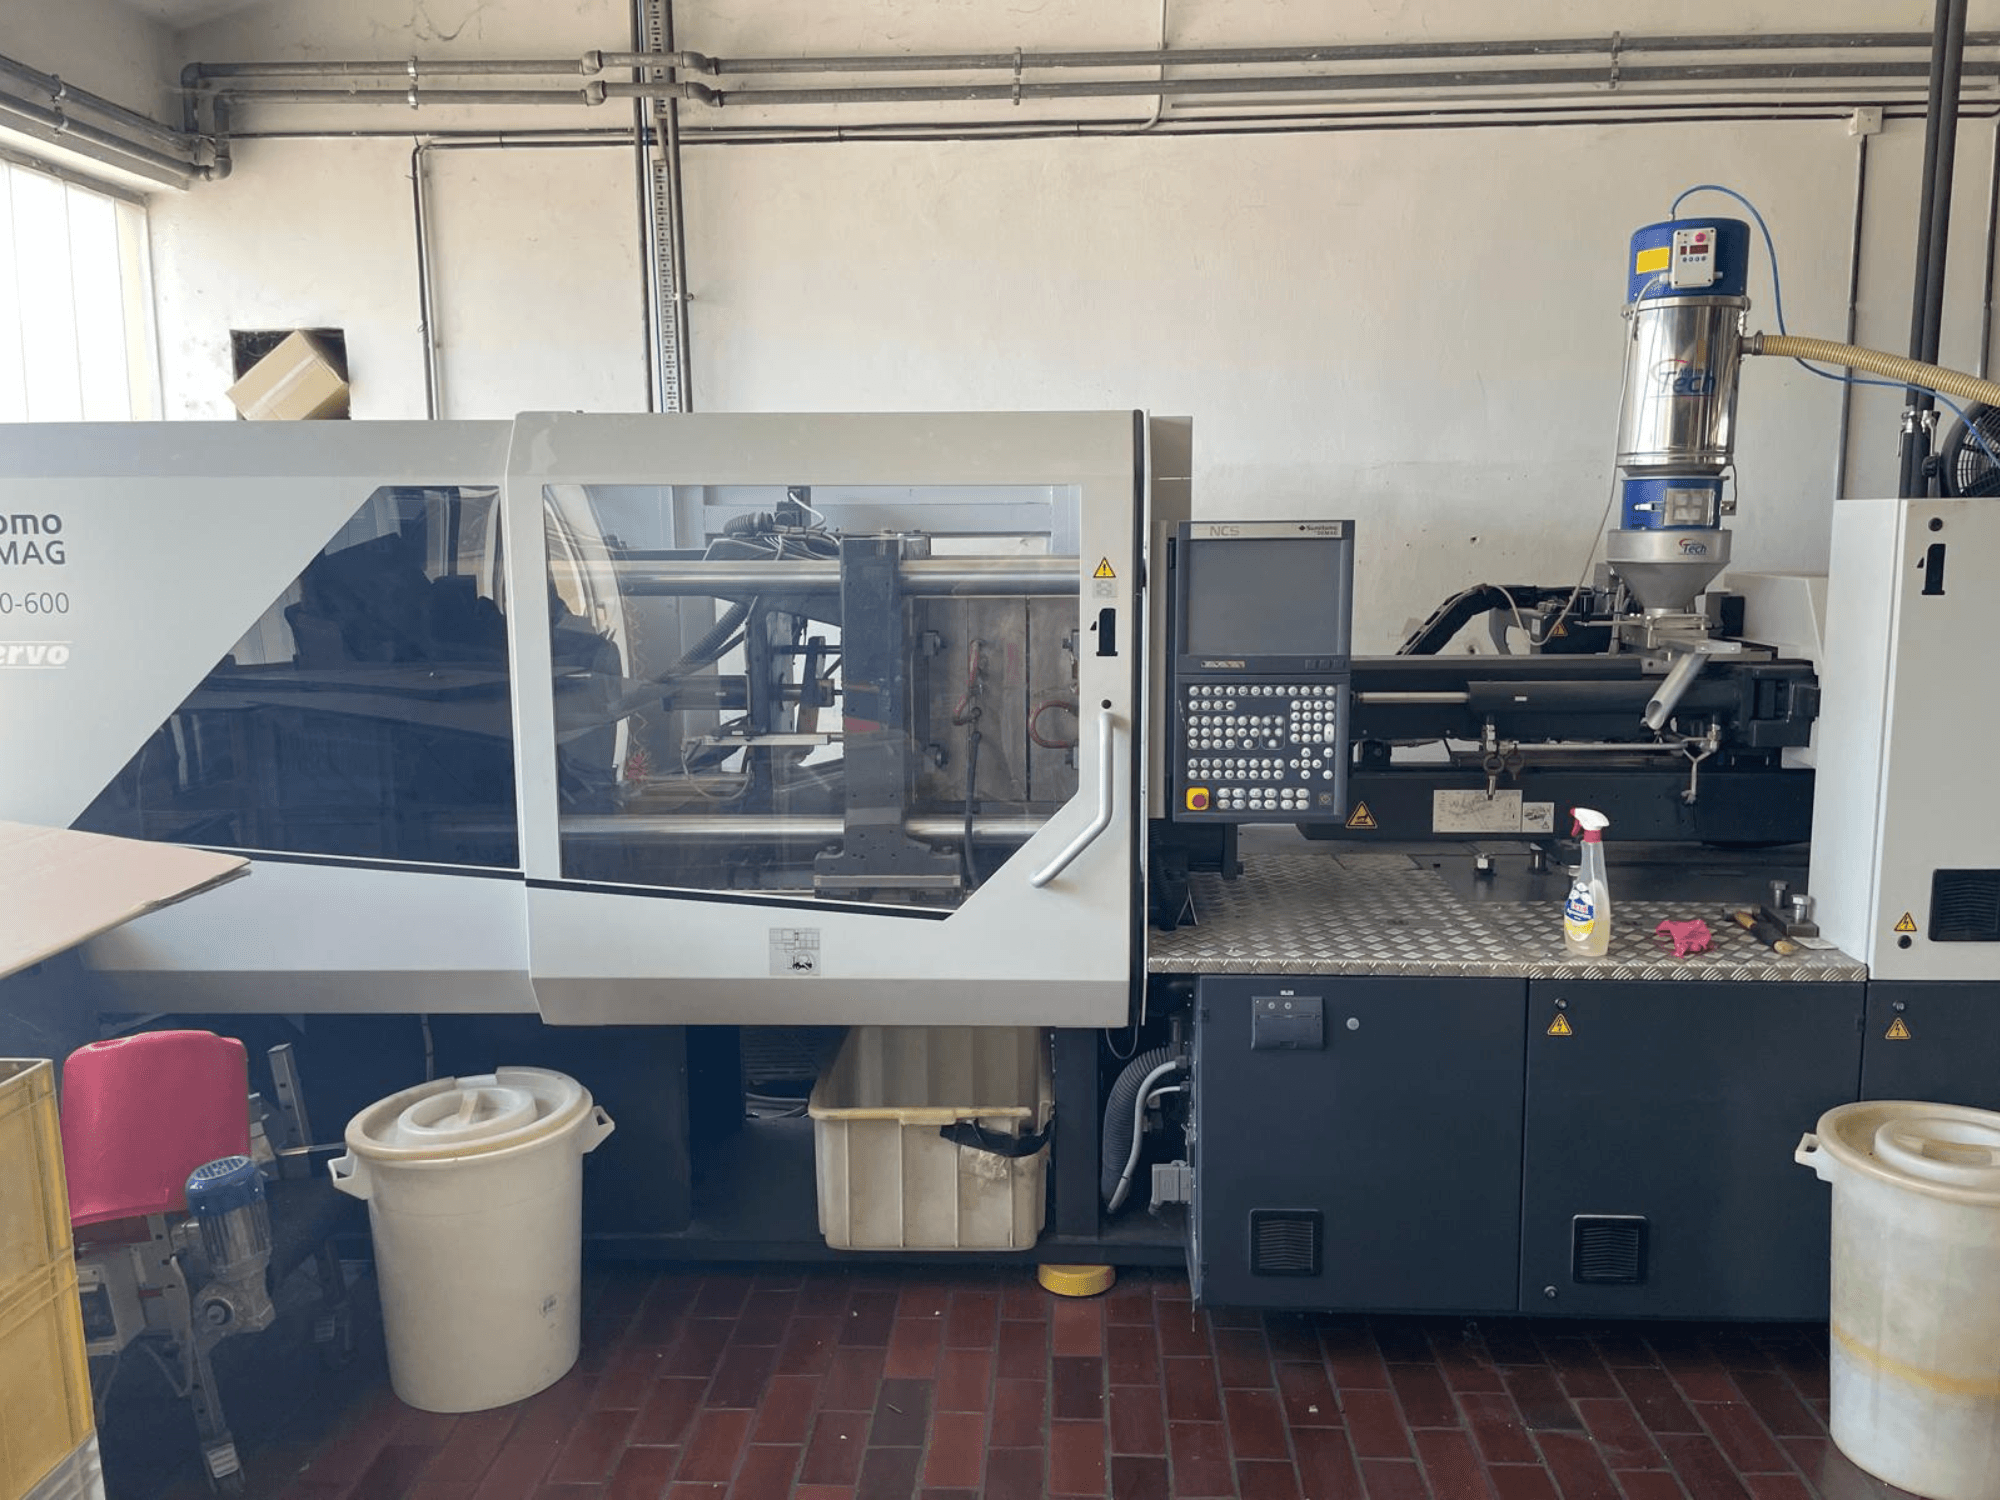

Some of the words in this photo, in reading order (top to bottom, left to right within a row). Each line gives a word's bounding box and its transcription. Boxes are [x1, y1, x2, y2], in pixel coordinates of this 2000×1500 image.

[1660, 368, 1716, 393] Tech
[1210, 525, 1240, 537] NCS
[0, 592, 70, 614] 0-600
